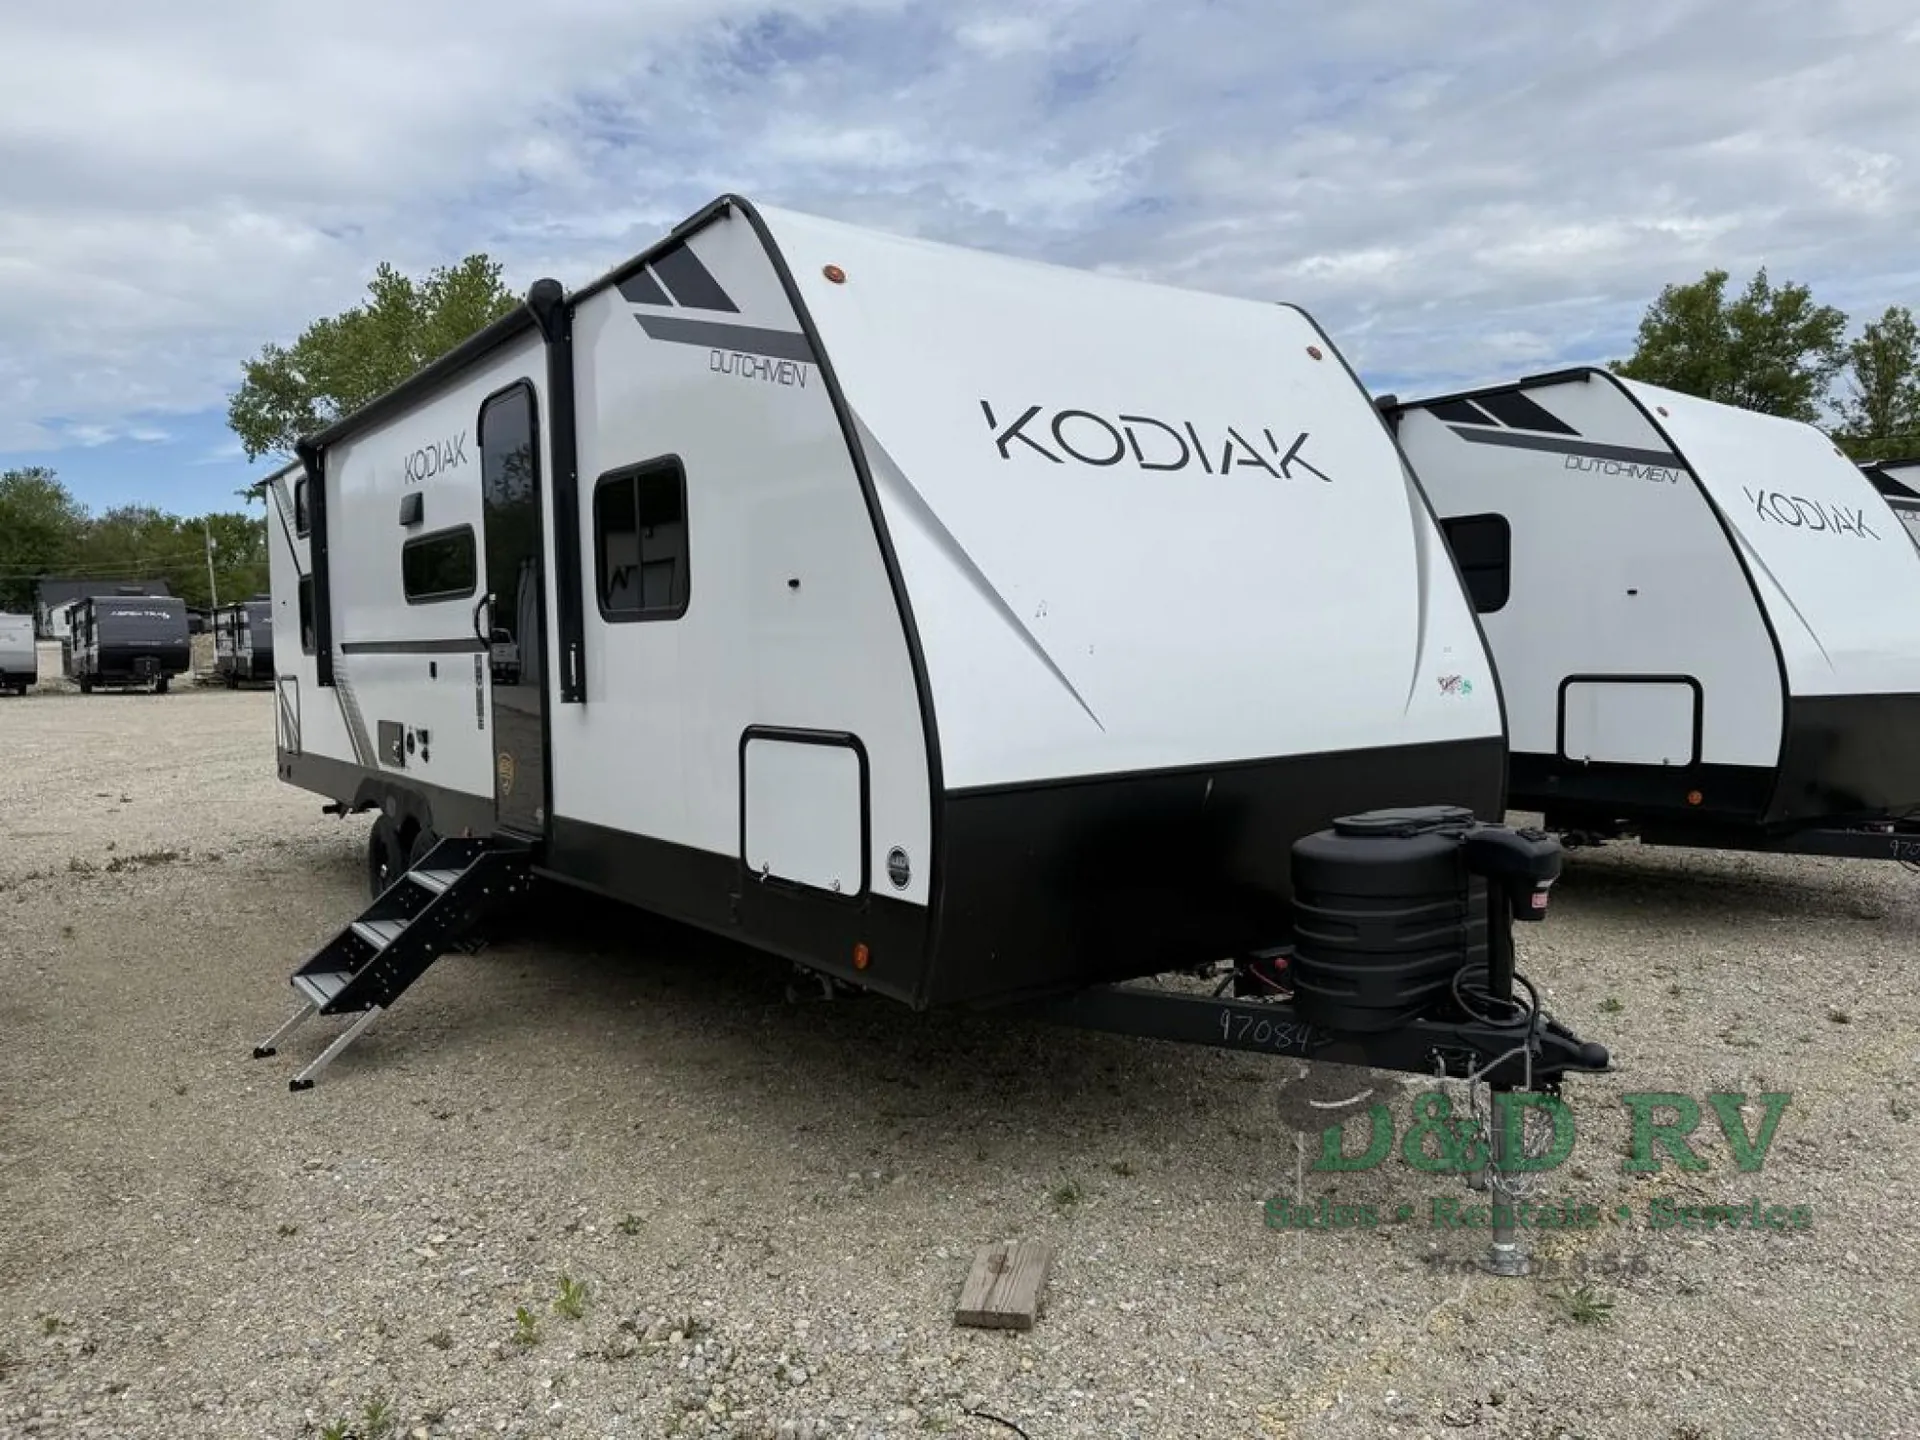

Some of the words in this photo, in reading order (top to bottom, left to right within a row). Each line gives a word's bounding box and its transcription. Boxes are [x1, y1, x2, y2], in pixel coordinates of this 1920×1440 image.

[709, 350, 808, 389] DUTCHMEN
[404, 430, 468, 485] KODIAK
[979, 399, 1333, 483] KODIAK
[1565, 455, 1679, 484] DUTCHMEN
[1742, 485, 1881, 540] KODIAK
